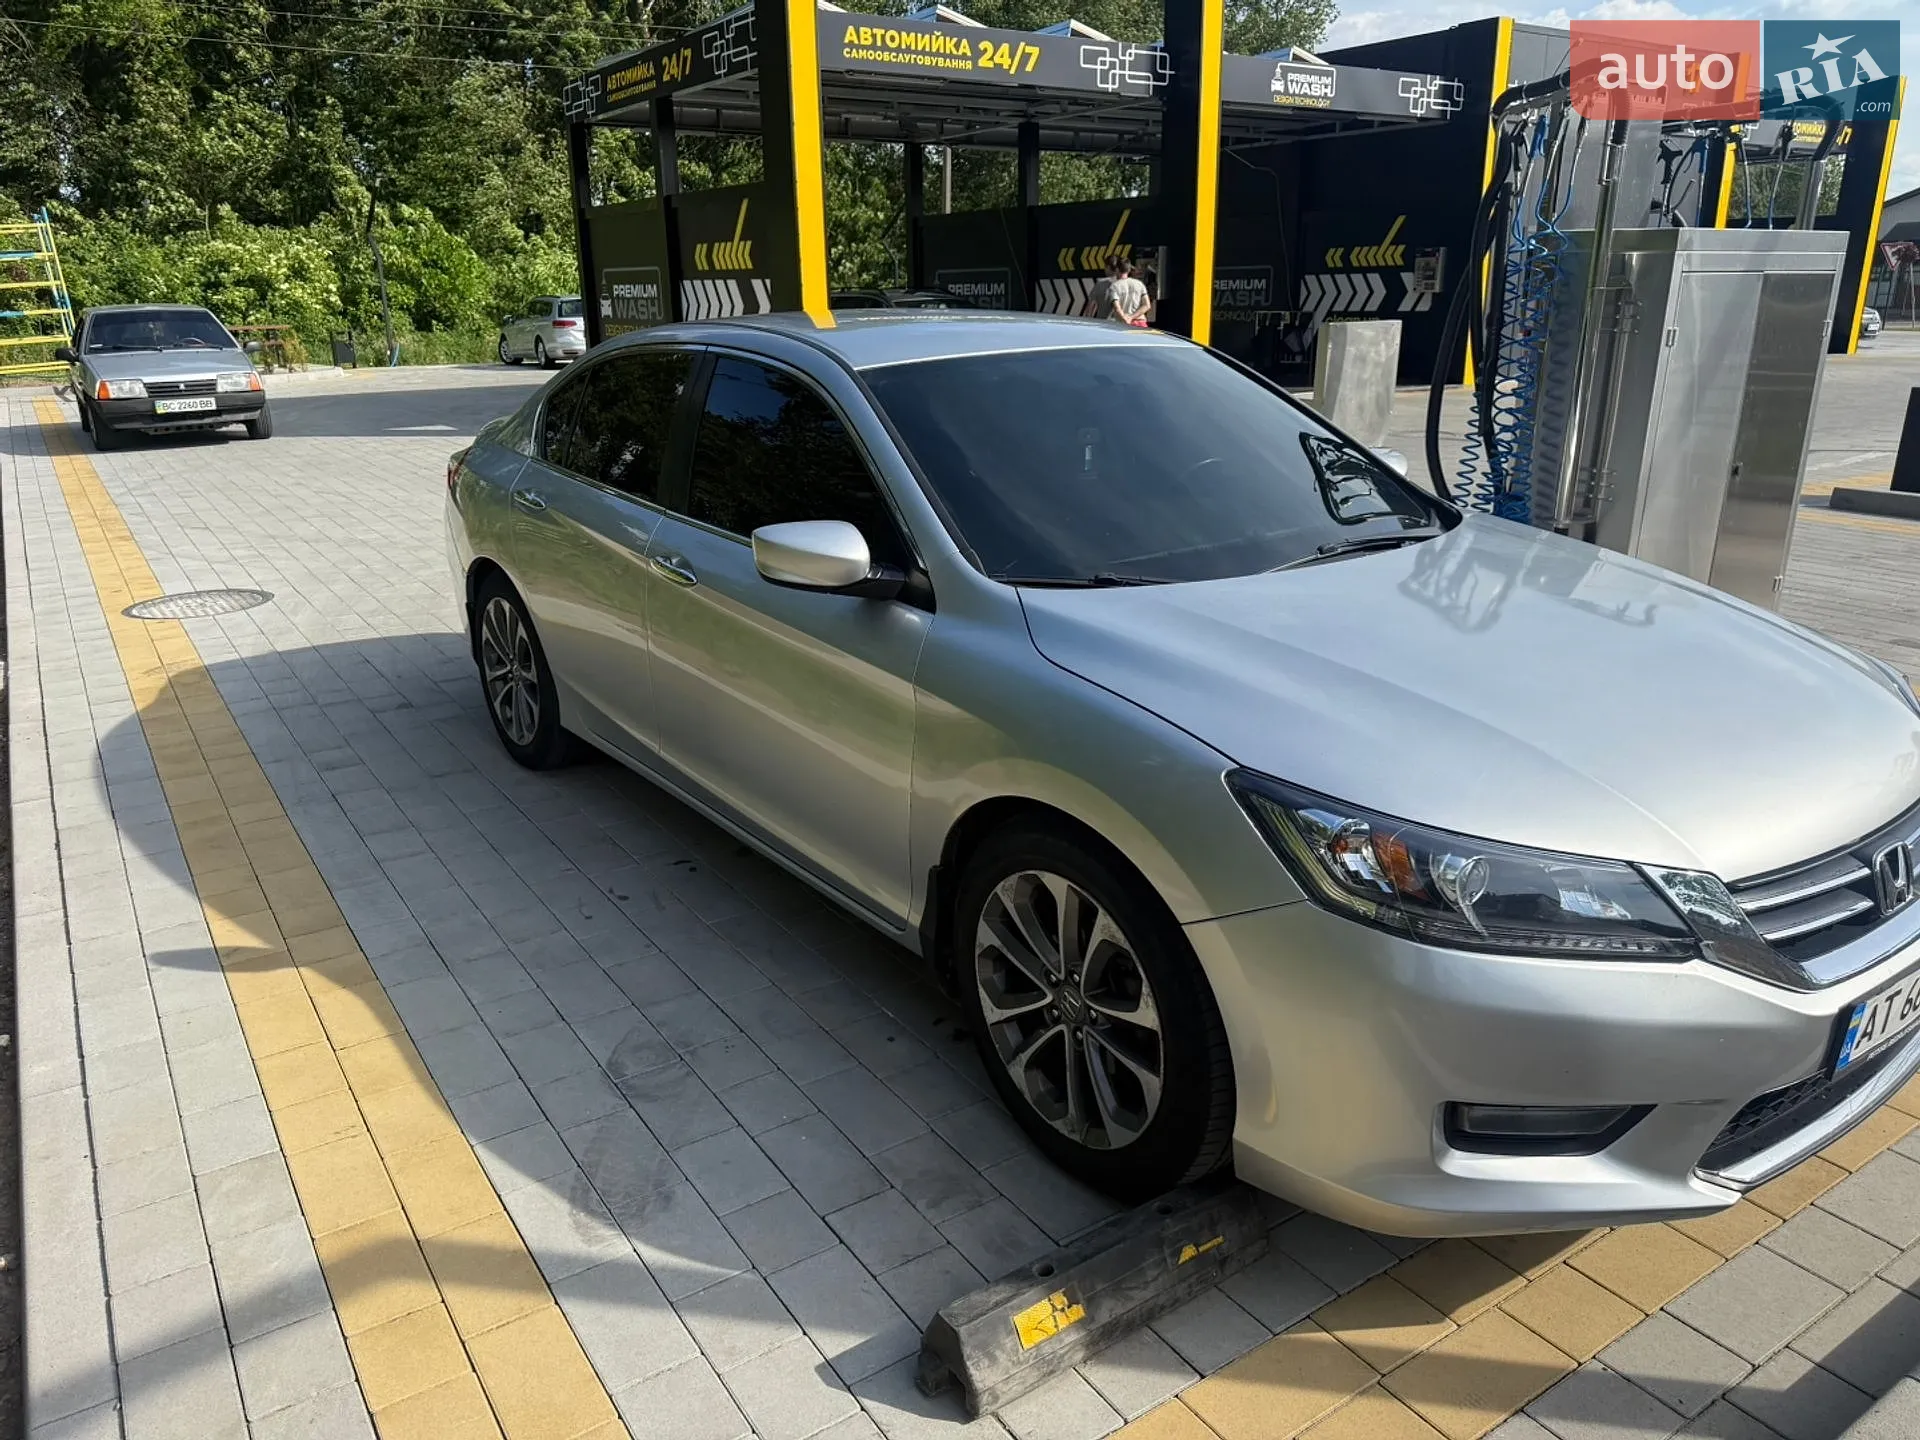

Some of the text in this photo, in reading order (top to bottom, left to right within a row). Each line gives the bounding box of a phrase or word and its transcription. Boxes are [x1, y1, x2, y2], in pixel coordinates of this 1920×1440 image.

[843, 47, 973, 70] САМООБСЛУГОВУВАННЯ
[844, 25, 1040, 74] АВТОМИЙКА 24/7
[606, 47, 692, 92] АВТОМИЙКА 24/7
[1287, 73, 1332, 85] PREMIUM
[1287, 82, 1332, 97] WASH
[613, 284, 657, 298] PREMIUM
[1213, 279, 1267, 290] REMIUM
[614, 299, 660, 320] WASH
[1854, 988, 1902, 1051] AT
